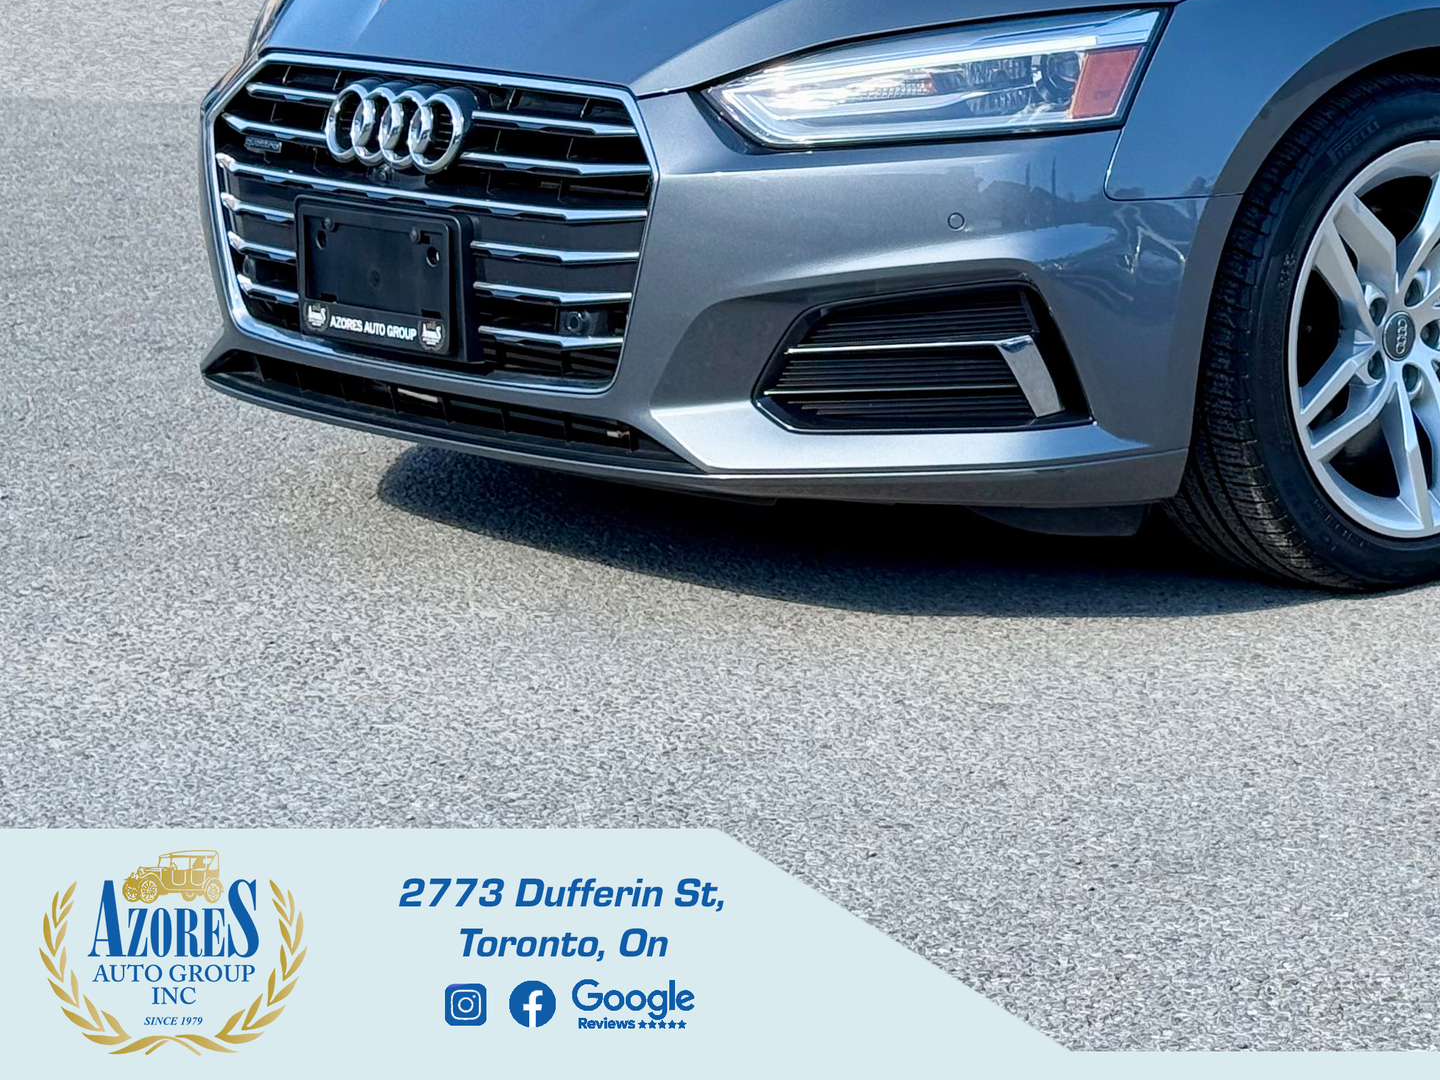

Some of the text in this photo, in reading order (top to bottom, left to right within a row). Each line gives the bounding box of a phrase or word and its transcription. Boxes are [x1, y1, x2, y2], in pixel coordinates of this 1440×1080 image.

[330, 315, 363, 332] AZORES
[364, 320, 386, 336] AUTO
[386, 324, 417, 341] GROUP
